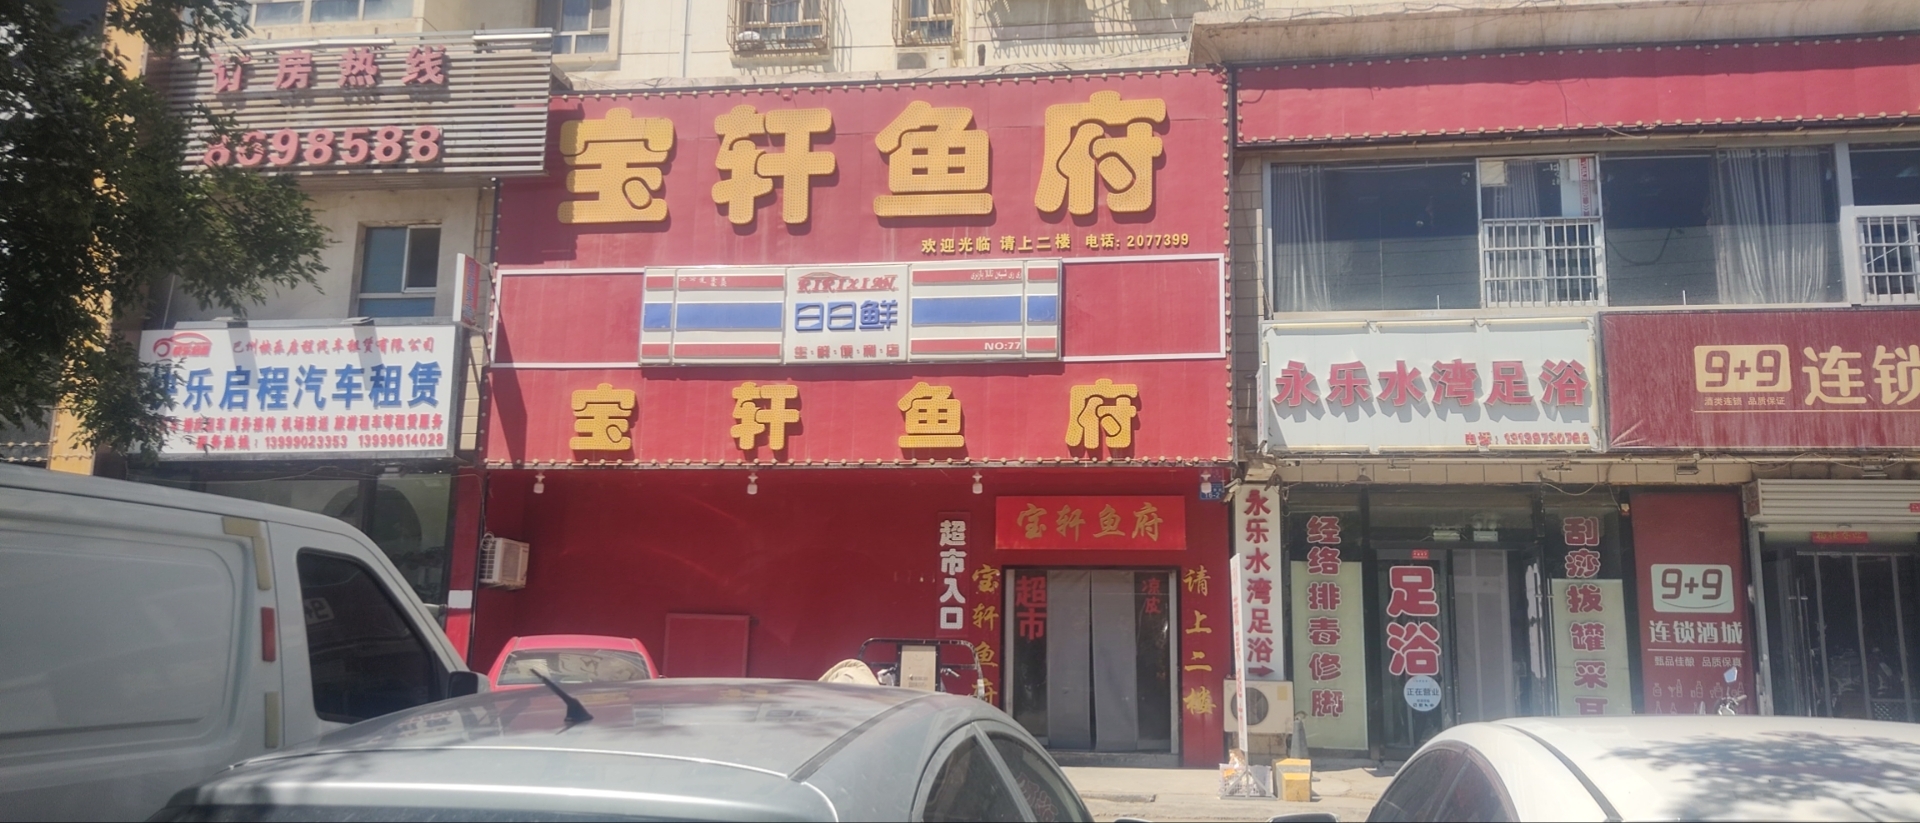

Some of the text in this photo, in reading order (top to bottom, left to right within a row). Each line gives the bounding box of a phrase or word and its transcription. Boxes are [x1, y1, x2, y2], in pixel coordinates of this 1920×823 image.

[208, 45, 447, 93] 订房热线
[558, 90, 1167, 225] 宝轩鱼府
[921, 236, 991, 253] 欢迎光临
[1000, 232, 1071, 251] 请上二楼
[1126, 233, 1189, 247] 2077399
[795, 300, 898, 331] 日日鲜
[1272, 358, 1589, 407] 永乐水湾足浴
[1704, 350, 1782, 388] 9+9
[1802, 344, 1920, 406] 连锁
[569, 379, 1139, 451] 宝轩鱼府
[1704, 396, 1742, 406] 酒类连锁
[265, 434, 348, 449] 13999023353
[358, 433, 444, 448] 13999614028
[1016, 502, 1164, 542] 宝轩鱼府
[939, 520, 967, 630] 超市入口
[1244, 489, 1275, 663] 永乐水湾足浴
[1661, 568, 1722, 600] 9+9
[1015, 575, 1047, 640] 超市
[1306, 515, 1345, 718] 经络排毒修脚
[1386, 565, 1441, 676] 足浴
[1182, 565, 1216, 715] 请上二楼
[1649, 620, 1742, 644] 连锁酒城
[1406, 687, 1439, 696] 正在营业
